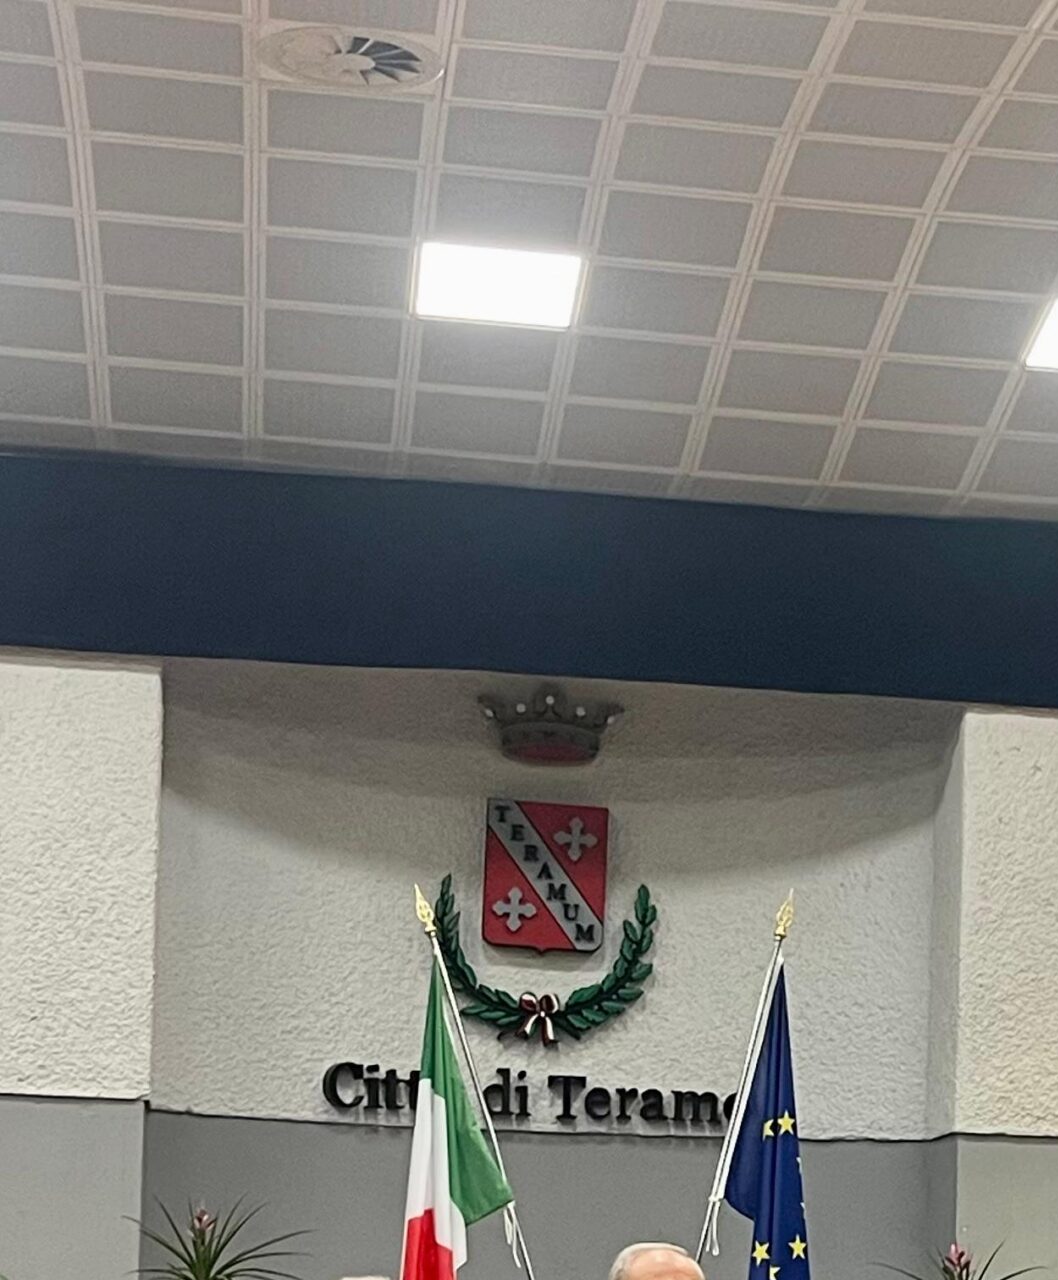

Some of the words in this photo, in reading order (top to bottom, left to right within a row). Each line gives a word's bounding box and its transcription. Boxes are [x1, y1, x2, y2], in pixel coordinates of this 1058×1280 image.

[494, 805, 595, 943] TERAMUM
[322, 1061, 420, 1111] Citt
[482, 1066, 530, 1117] di
